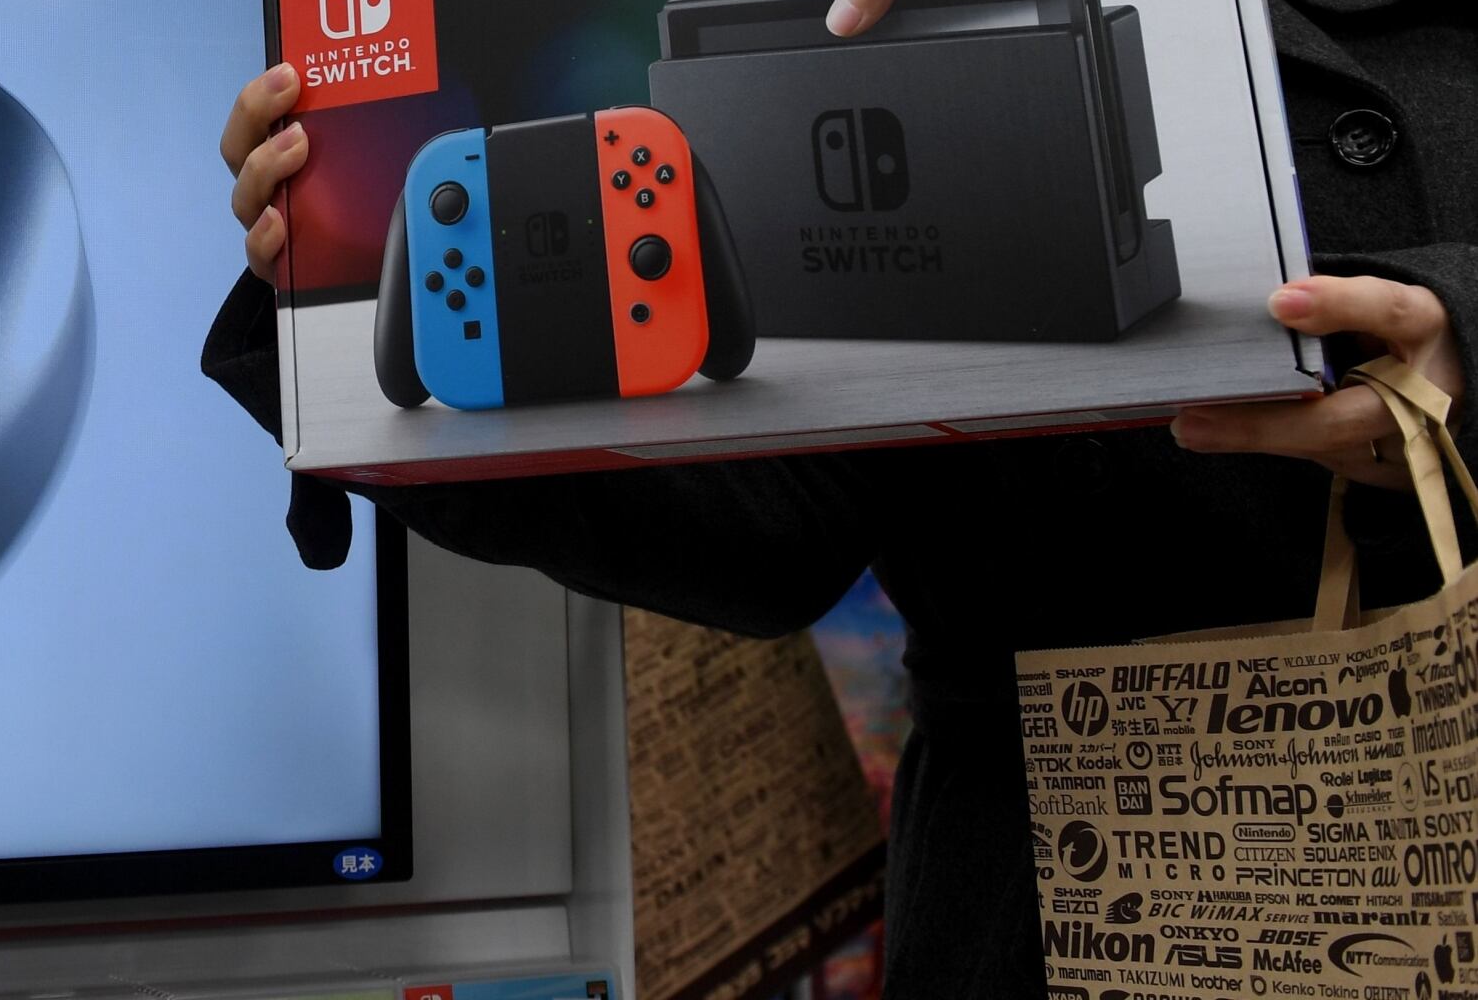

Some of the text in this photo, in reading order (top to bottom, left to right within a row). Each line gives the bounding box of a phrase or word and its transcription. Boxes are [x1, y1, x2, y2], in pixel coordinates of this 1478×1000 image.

[306, 38, 410, 65] NINTENDO
[800, 225, 940, 242] NINTENDO
[802, 246, 943, 273] SWITCH
[1238, 657, 1279, 673] NEC
[1283, 653, 1340, 667] WOWOW
[1056, 667, 1106, 679] SHARP
[1112, 662, 1230, 693] BUFFALO
[1245, 674, 1327, 699] Alcon
[1116, 696, 1146, 711] JVC
[1153, 695, 1199, 722] Y!
[1207, 693, 1383, 734] lenovo
[1112, 719, 1144, 736] 弥生
[1163, 726, 1196, 735] mobile
[1030, 743, 1073, 754] DAIKIN
[1156, 743, 1182, 755] NTT
[1233, 739, 1275, 750] SONY
[1033, 757, 1074, 772] TDK
[1077, 755, 1123, 771] Kodak
[1158, 756, 1183, 767] 西日本
[1042, 776, 1106, 791] TAMRON
[1116, 781, 1148, 796] BAN
[1029, 793, 1108, 816] SoftBank
[1118, 796, 1145, 810] DAI
[1159, 774, 1317, 826] Sofmap
[1425, 810, 1473, 837] SONY
[1238, 827, 1291, 839] Nintendo
[1307, 822, 1370, 843] SIGMA
[1112, 831, 1226, 860] TREND
[1303, 845, 1397, 862] SQUARE ENIX
[1234, 847, 1296, 862] CITIZEN
[341, 854, 375, 873] 見本
[1118, 863, 1225, 881] MICRO
[1372, 866, 1400, 887] au
[1053, 887, 1102, 898] SHARP
[1150, 890, 1194, 900] SONY
[1213, 891, 1252, 902] HAKUBA
[1255, 893, 1290, 905] EPSON
[1321, 895, 1361, 906] COMET
[1366, 895, 1403, 906] HITACHI
[1052, 899, 1099, 915] EIZO
[1148, 903, 1185, 917] BIC
[1264, 913, 1310, 924] SERVICE
[1313, 910, 1431, 926] marantz
[1160, 924, 1240, 941] ONKYO
[1247, 929, 1328, 946] BOSE
[1043, 920, 1155, 963] Nikon
[1164, 944, 1242, 969] ASUS
[1253, 948, 1322, 974] McAfee
[1345, 951, 1373, 965] NTT
[1057, 966, 1112, 982] maruman
[1117, 968, 1185, 988] TAKIZUMI
[1191, 974, 1243, 991] brother
[1272, 981, 1359, 999] Kenko Tokina
[1364, 985, 1410, 1000] ORIENT
